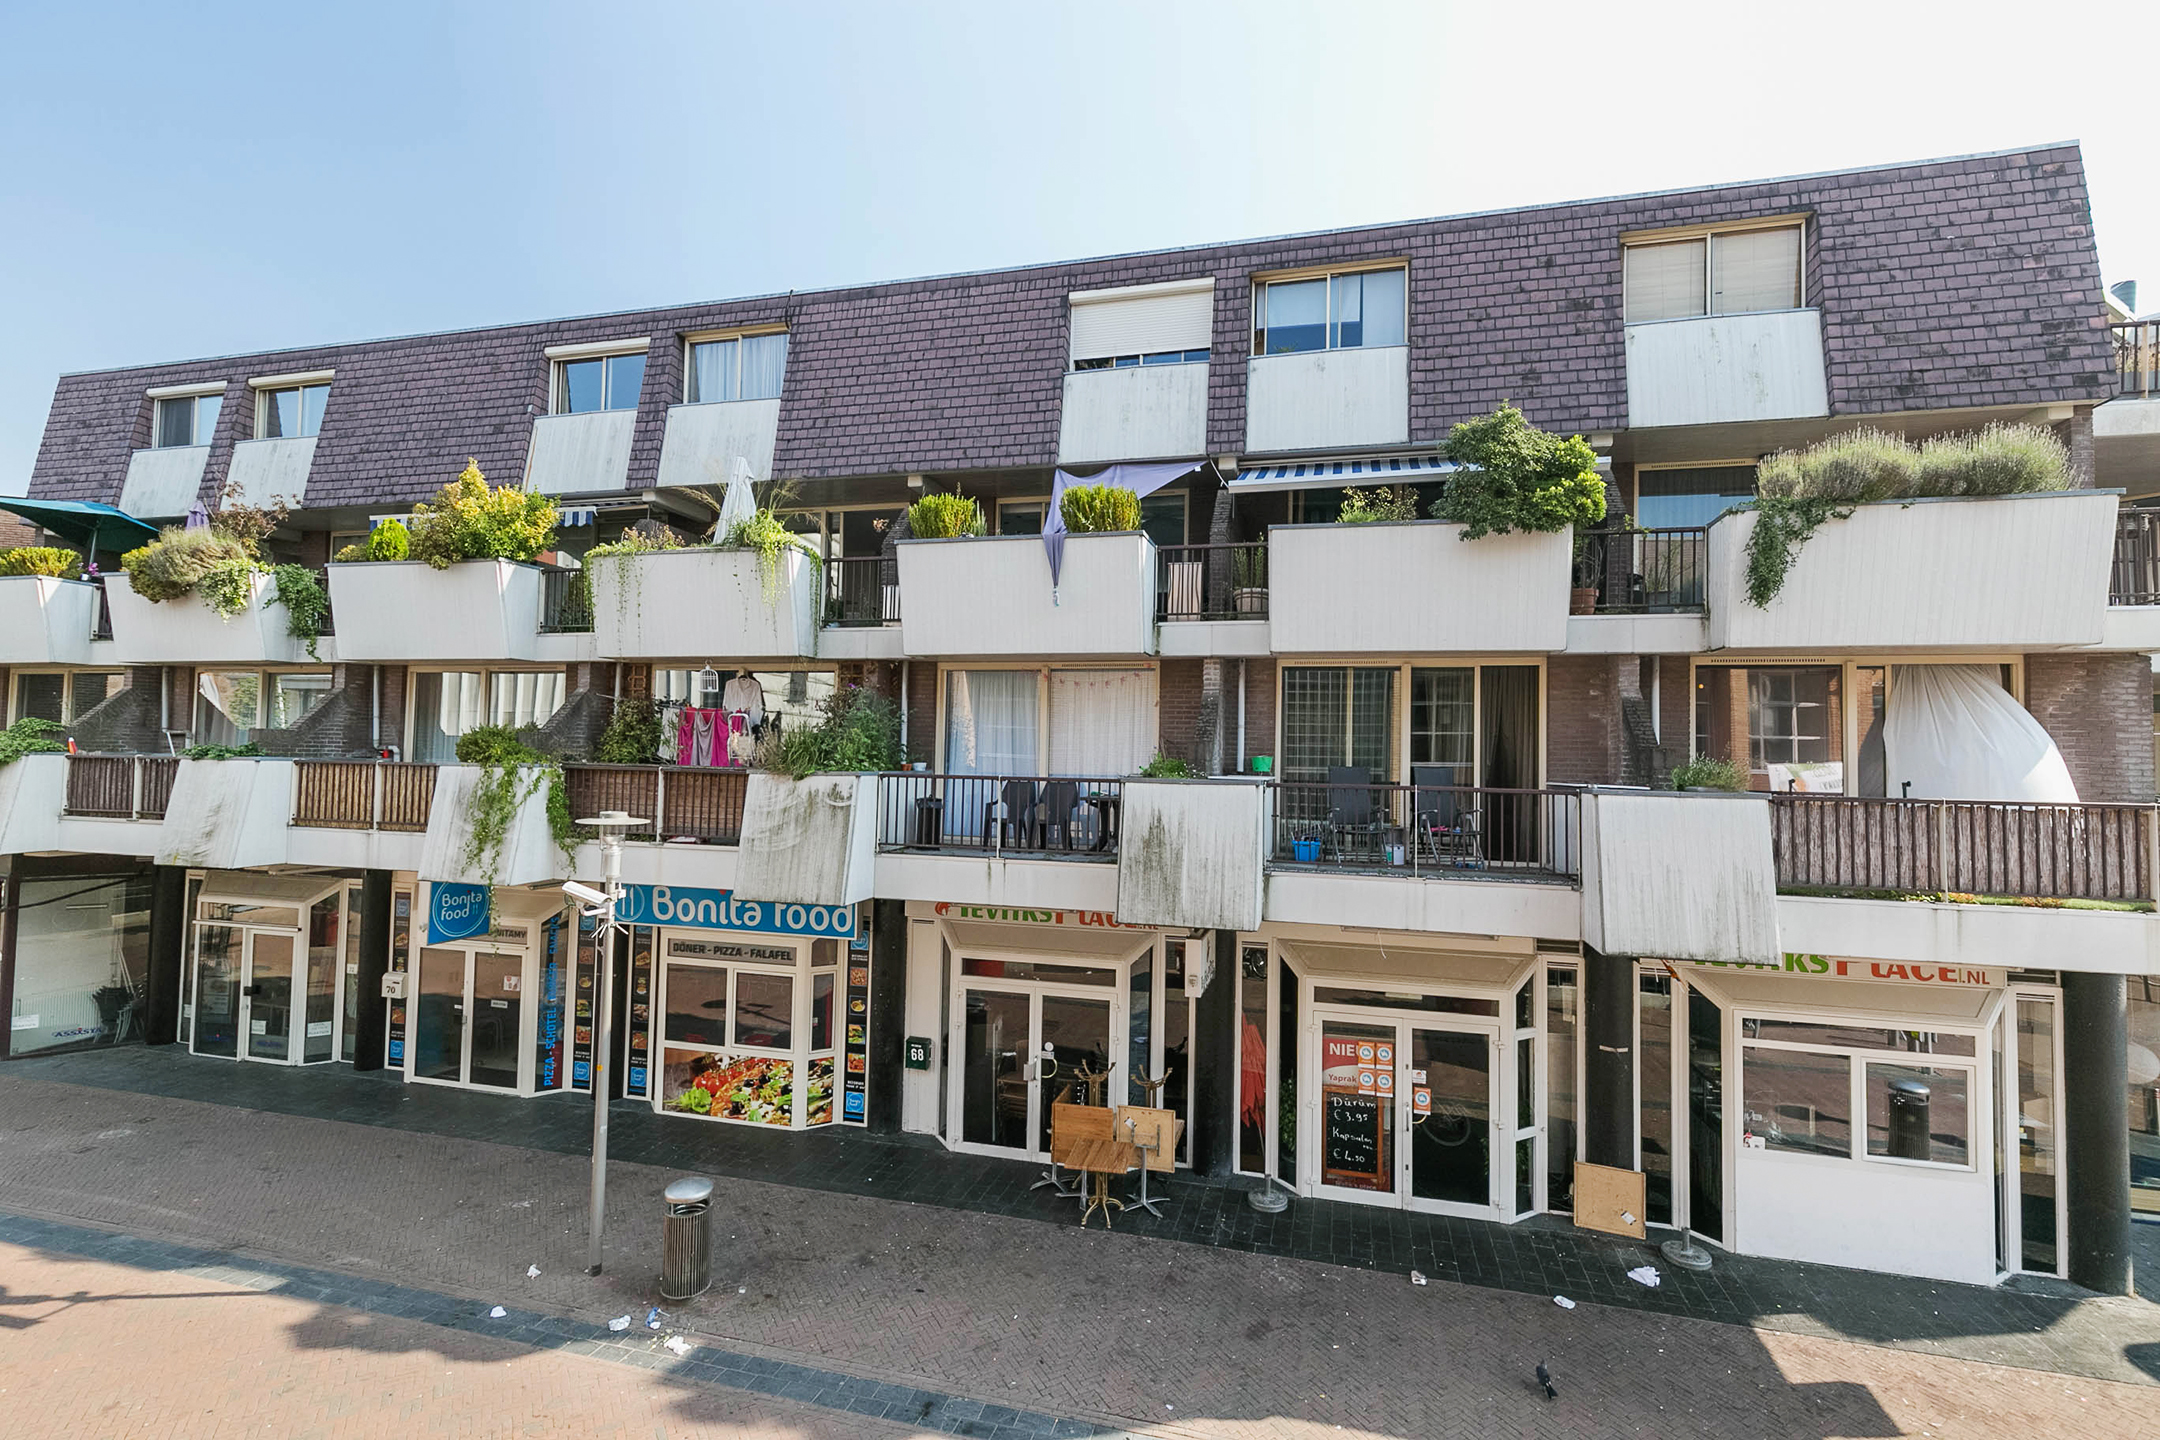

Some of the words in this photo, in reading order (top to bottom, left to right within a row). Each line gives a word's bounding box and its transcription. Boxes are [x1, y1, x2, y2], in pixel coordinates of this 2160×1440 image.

[442, 889, 482, 908] Bonita
[652, 886, 762, 926] Bonita
[441, 906, 470, 921] food
[673, 941, 707, 955] DÖNER
[713, 945, 742, 957] PIZZA
[750, 948, 793, 961] FALAFEL
[386, 985, 396, 994] 70
[545, 1007, 557, 1049] SCHOTEL
[911, 1048, 924, 1061] 68
[1329, 1043, 1359, 1057] NIE
[543, 1057, 555, 1086] PIZZA
[1328, 1074, 1357, 1084] Yaprak
[1345, 1111, 1368, 1122] 3.95
